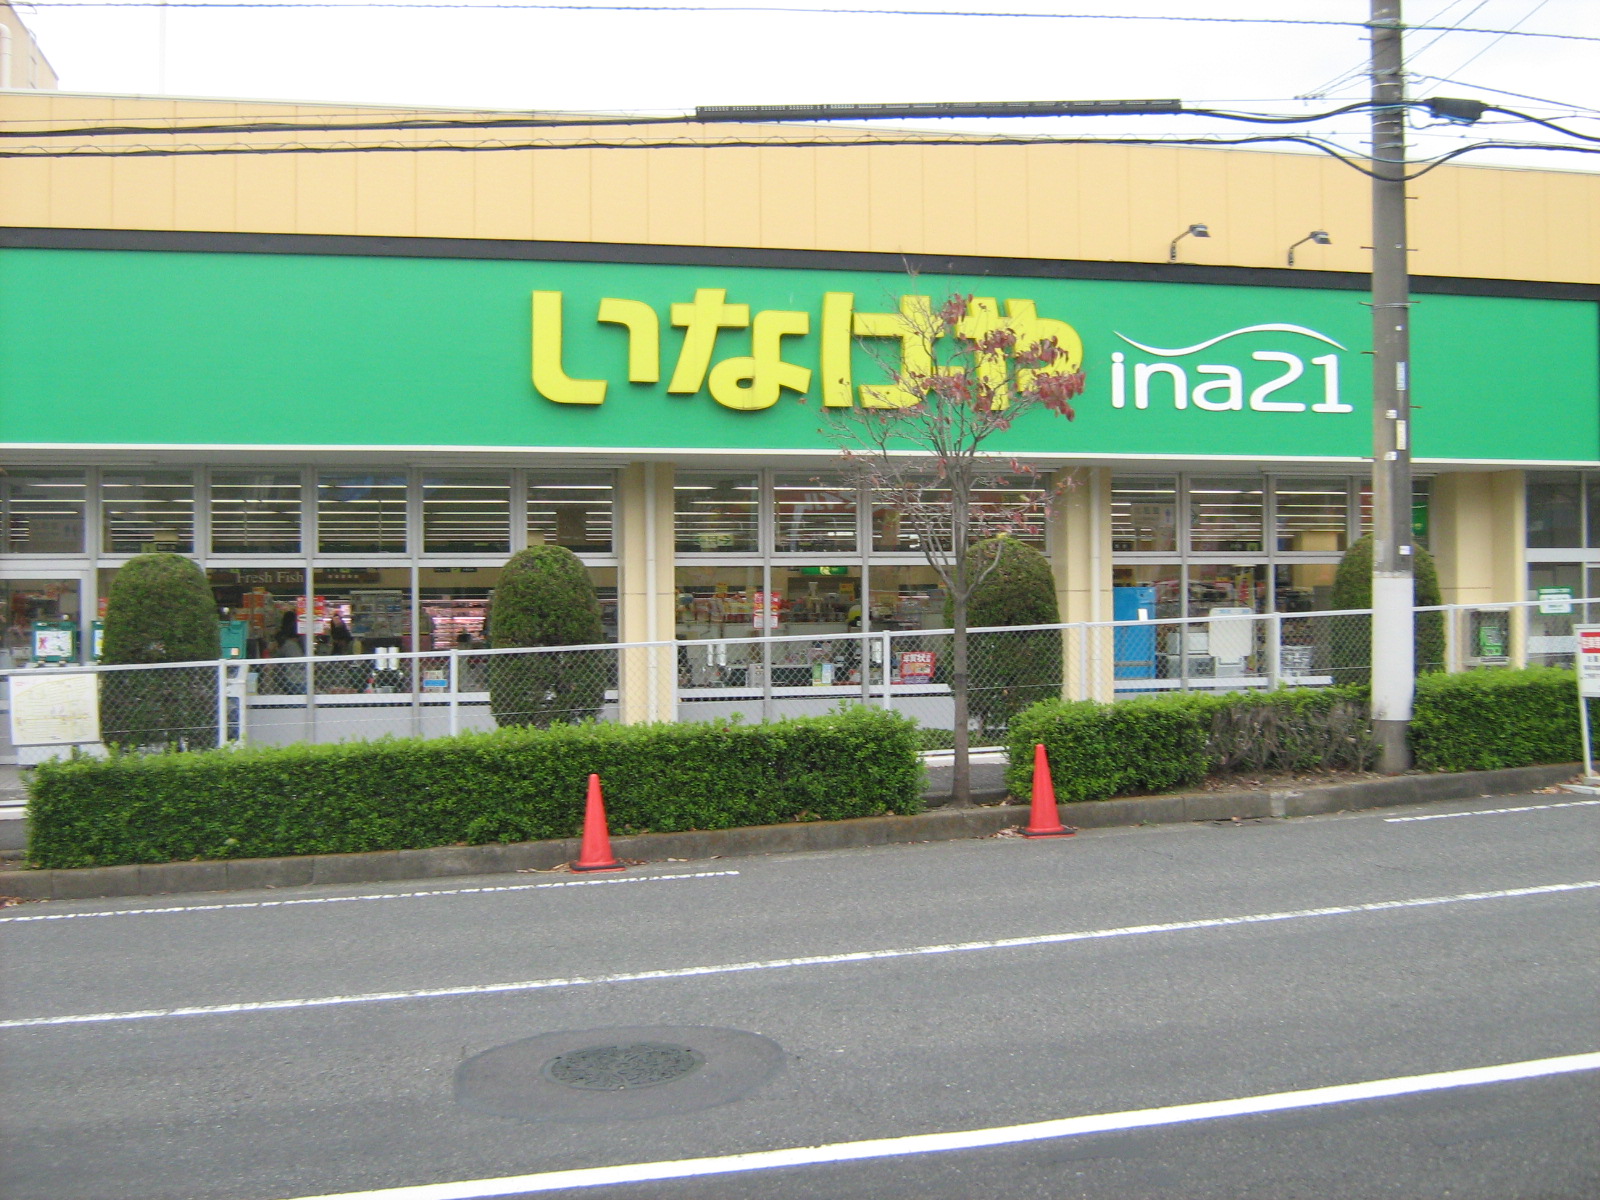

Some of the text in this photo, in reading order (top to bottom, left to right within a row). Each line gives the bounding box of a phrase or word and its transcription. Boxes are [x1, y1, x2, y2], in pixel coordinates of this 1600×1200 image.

[531, 287, 1083, 412] いなげや
[1111, 351, 1354, 413] ina21
[236, 571, 304, 585] Fresh Fish
